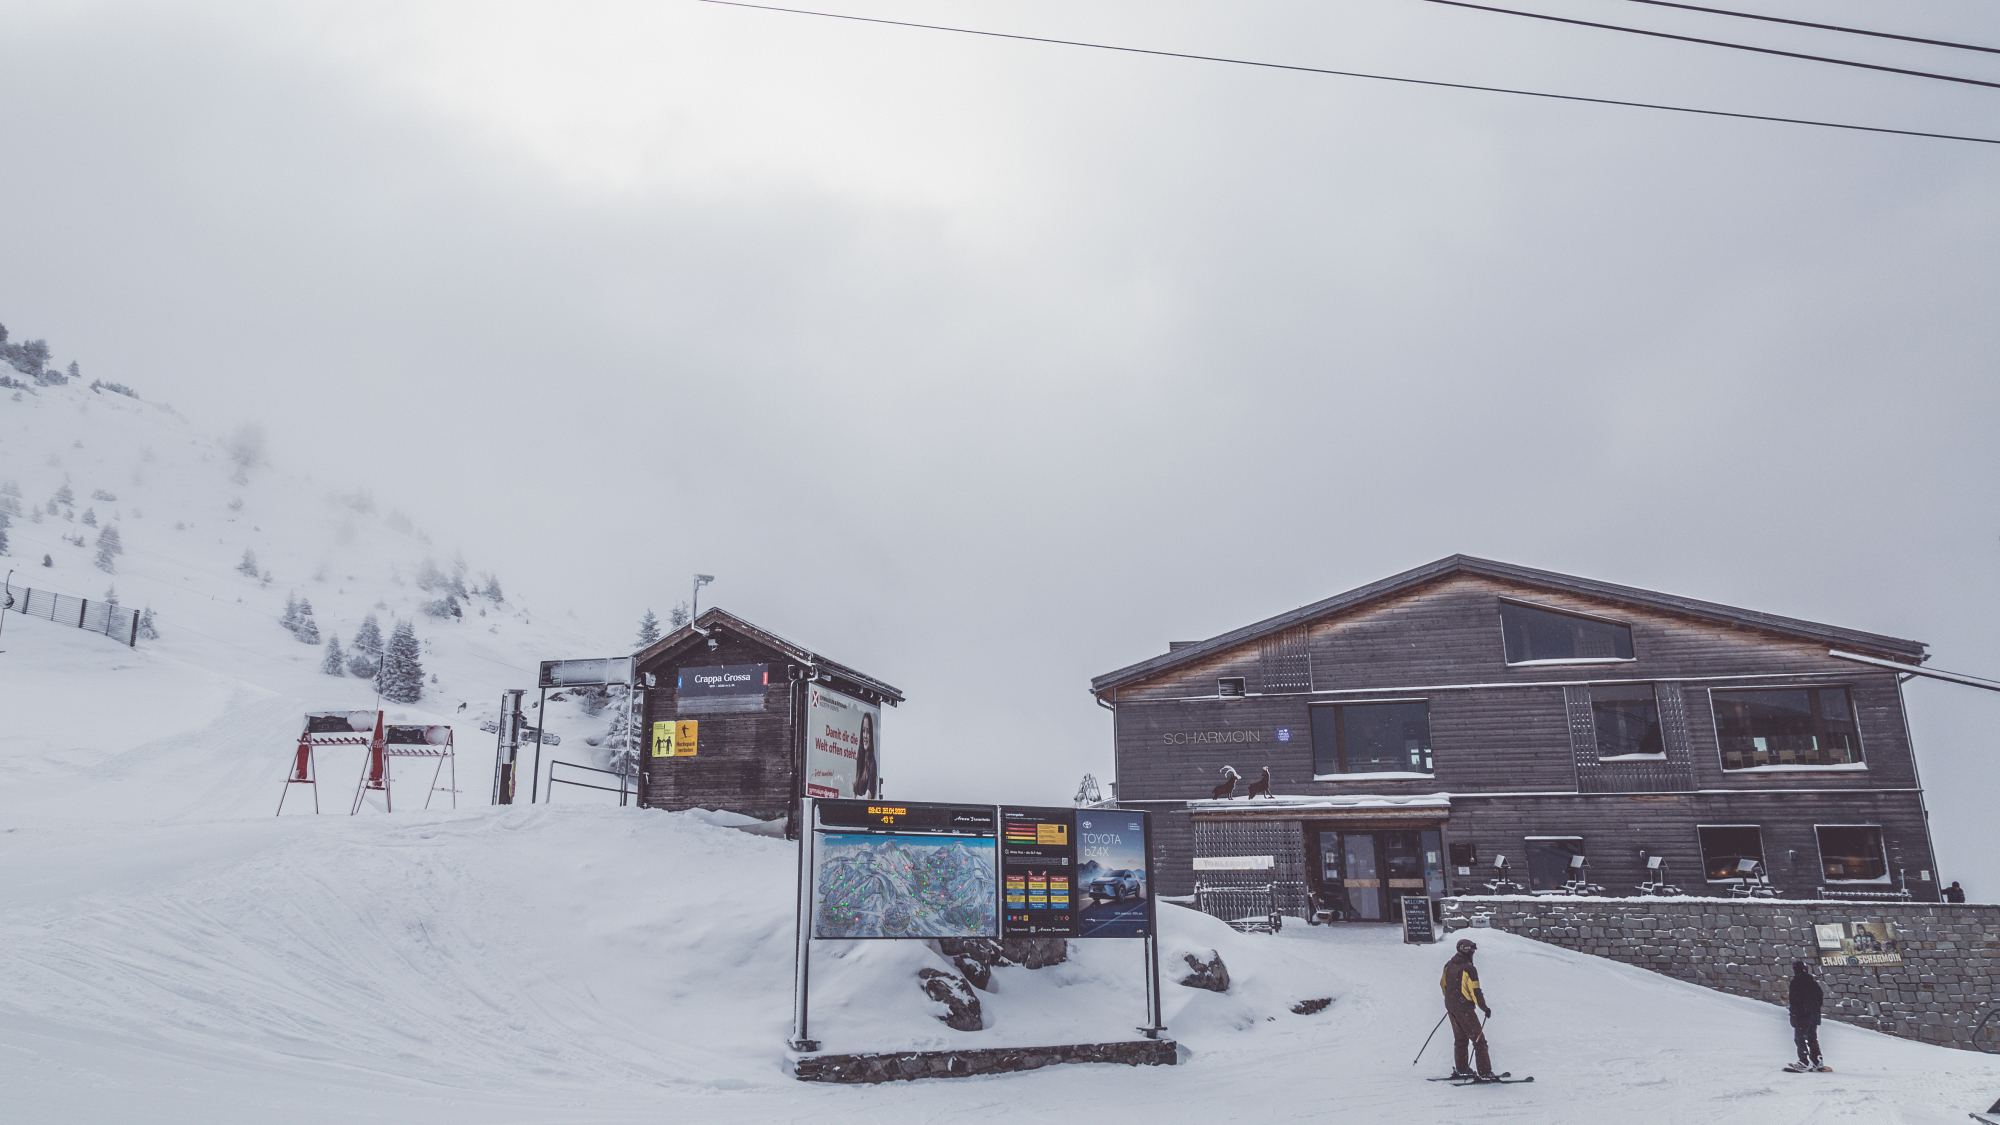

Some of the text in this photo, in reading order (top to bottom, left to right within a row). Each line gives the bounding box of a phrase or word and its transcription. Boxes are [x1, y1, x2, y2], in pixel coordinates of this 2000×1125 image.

[694, 673, 751, 684] Crappa Grossa
[825, 724, 858, 745] Damit dir die
[1163, 730, 1260, 745] SCHARMOIN
[815, 737, 857, 760] Welt offen steht.
[1082, 833, 1122, 845] TOYOTA
[1084, 846, 1109, 857] bZ4X
[1821, 956, 1848, 967] ENJOY
[1857, 953, 1902, 964] SCHARMOIN
